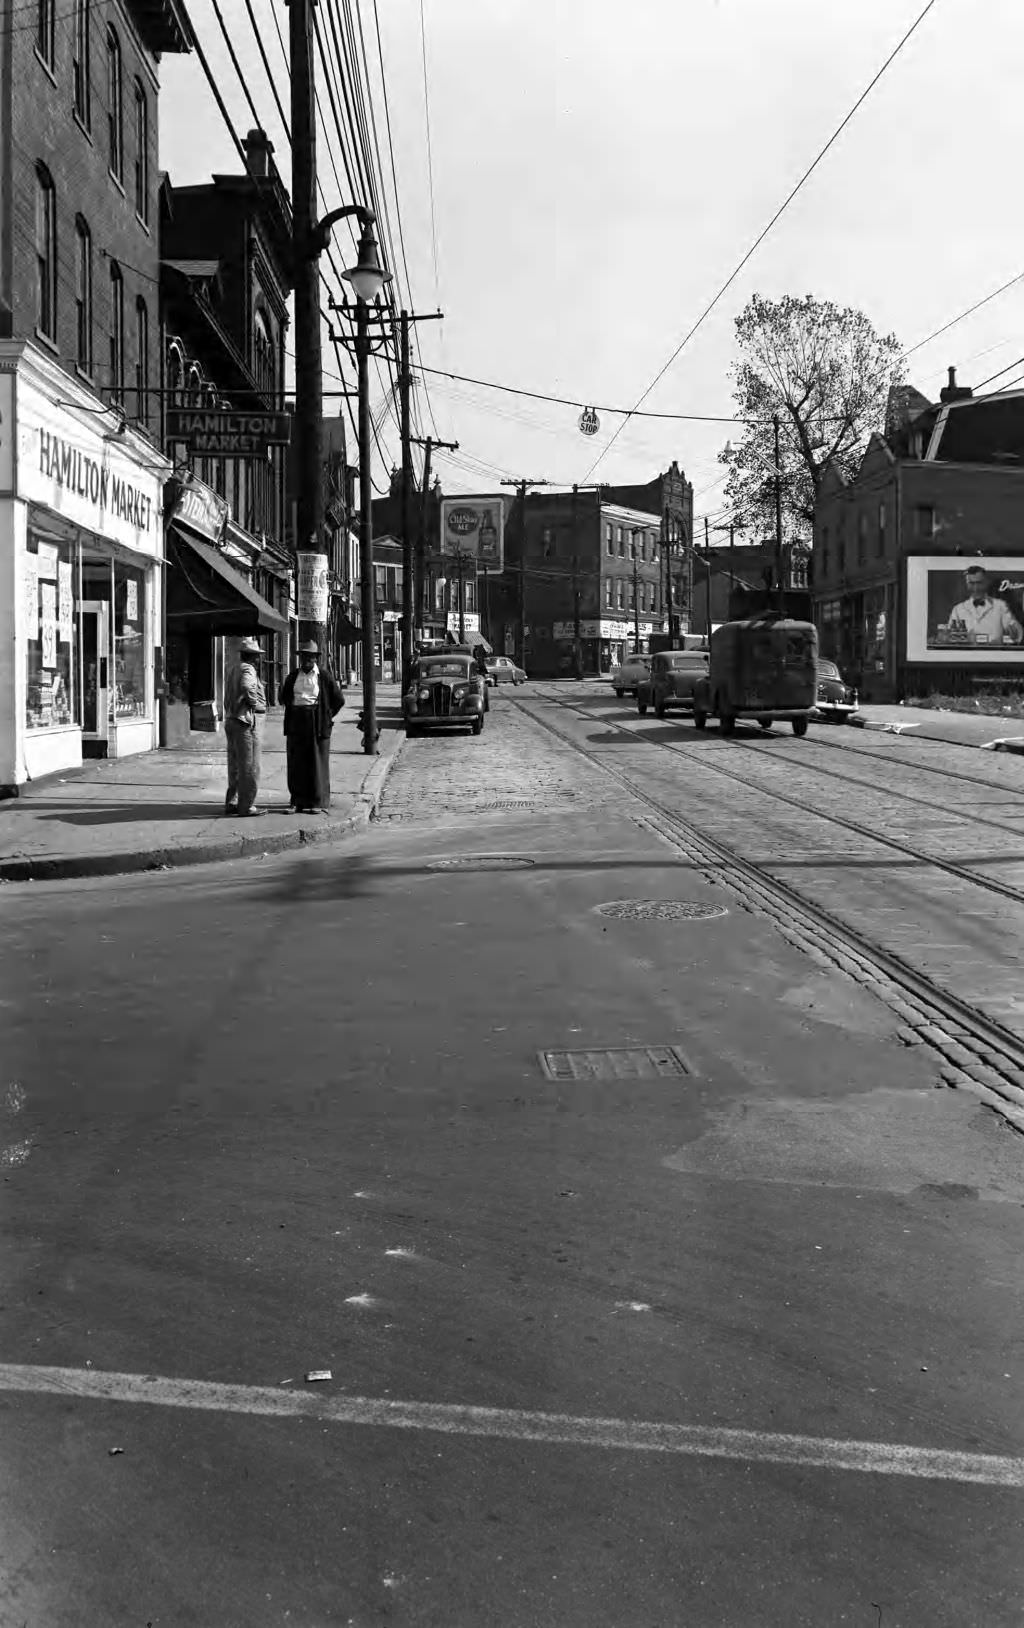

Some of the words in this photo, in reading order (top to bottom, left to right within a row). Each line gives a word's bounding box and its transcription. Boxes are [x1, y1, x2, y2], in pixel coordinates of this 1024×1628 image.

[178, 415, 277, 435] HAMILTON
[582, 413, 597, 424] CAR
[580, 422, 598, 432] STOP
[195, 434, 260, 450] MARKET
[39, 426, 108, 510] HAMILTON
[111, 473, 152, 532] MARKET
